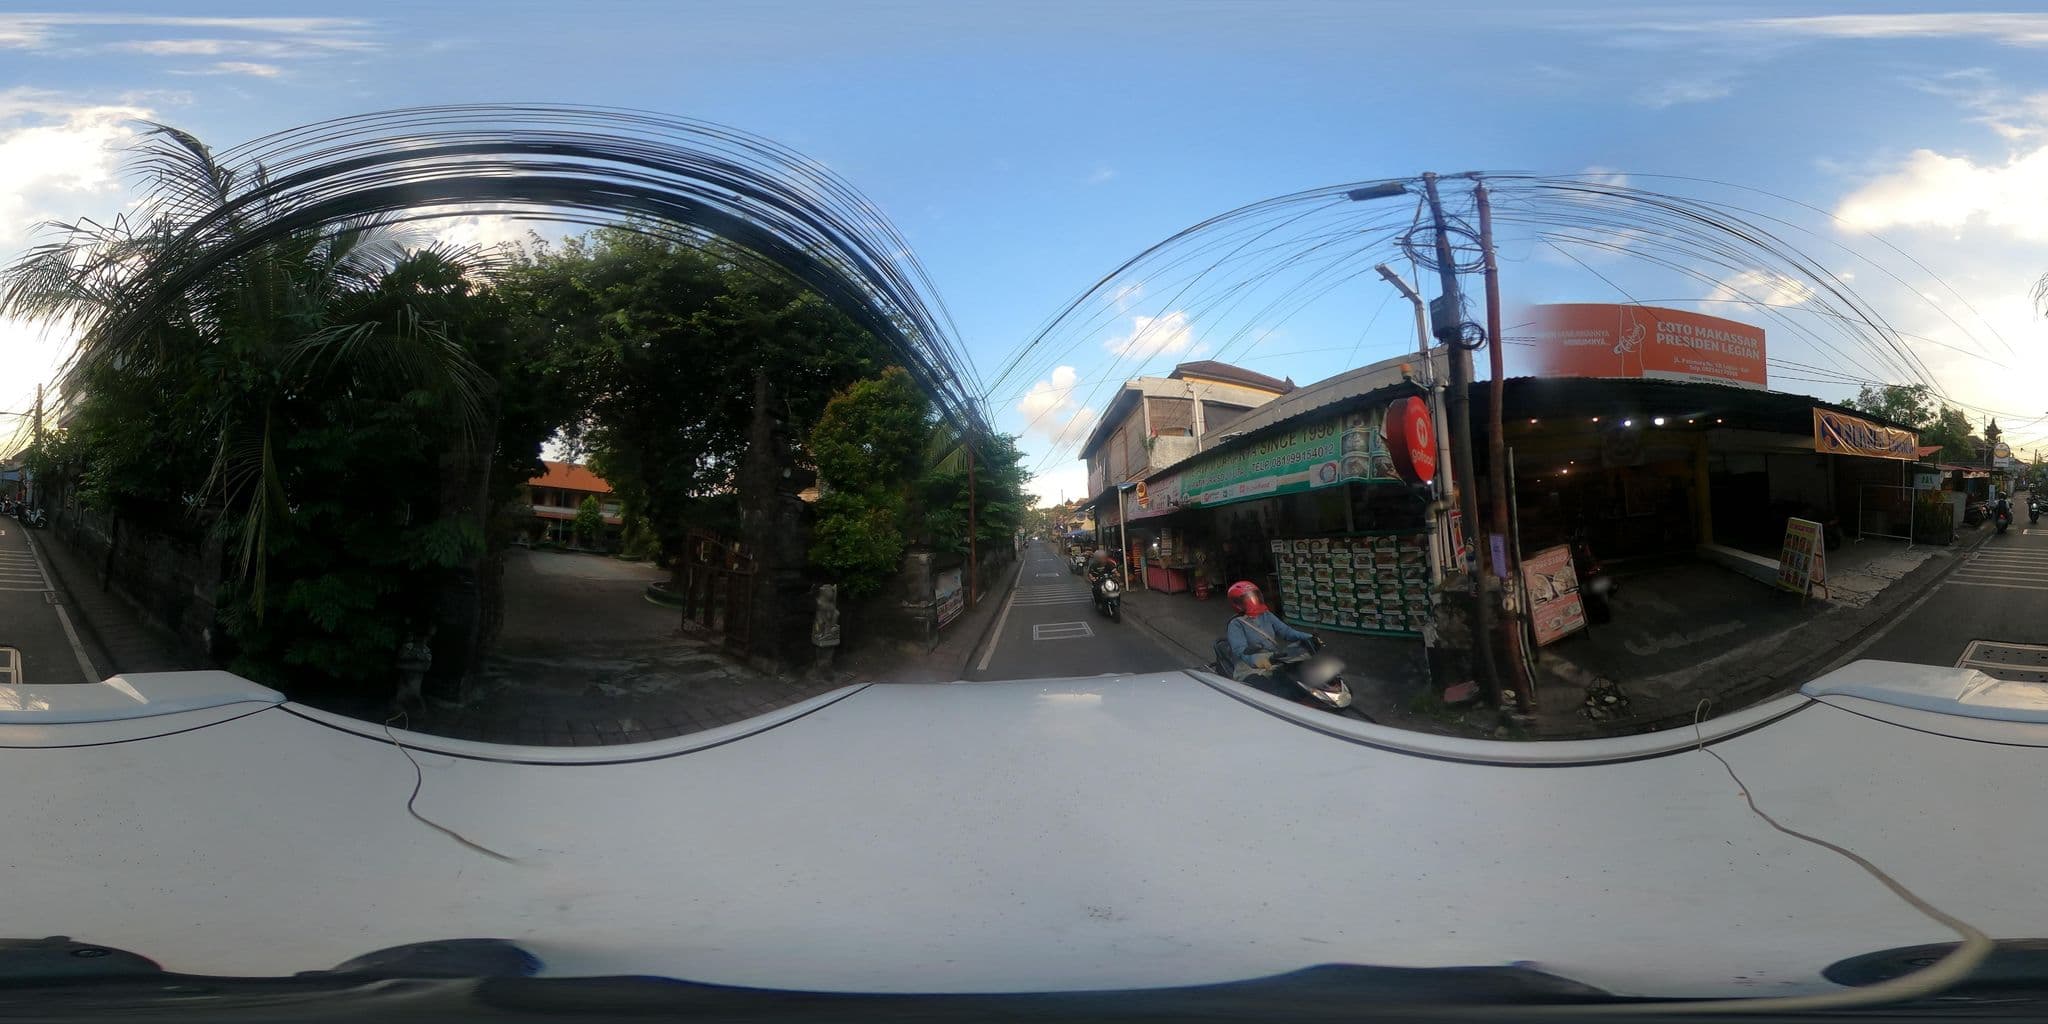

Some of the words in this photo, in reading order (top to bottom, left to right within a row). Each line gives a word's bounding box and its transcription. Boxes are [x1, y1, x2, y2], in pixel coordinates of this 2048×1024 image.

[1656, 321, 1692, 335] COTO
[1695, 326, 1758, 348] MAKASSAR
[1656, 332, 1720, 352] PRESIDEN
[1721, 343, 1760, 361] LEGIAN
[1260, 433, 1297, 455] SINCE
[1302, 423, 1336, 443] 1998
